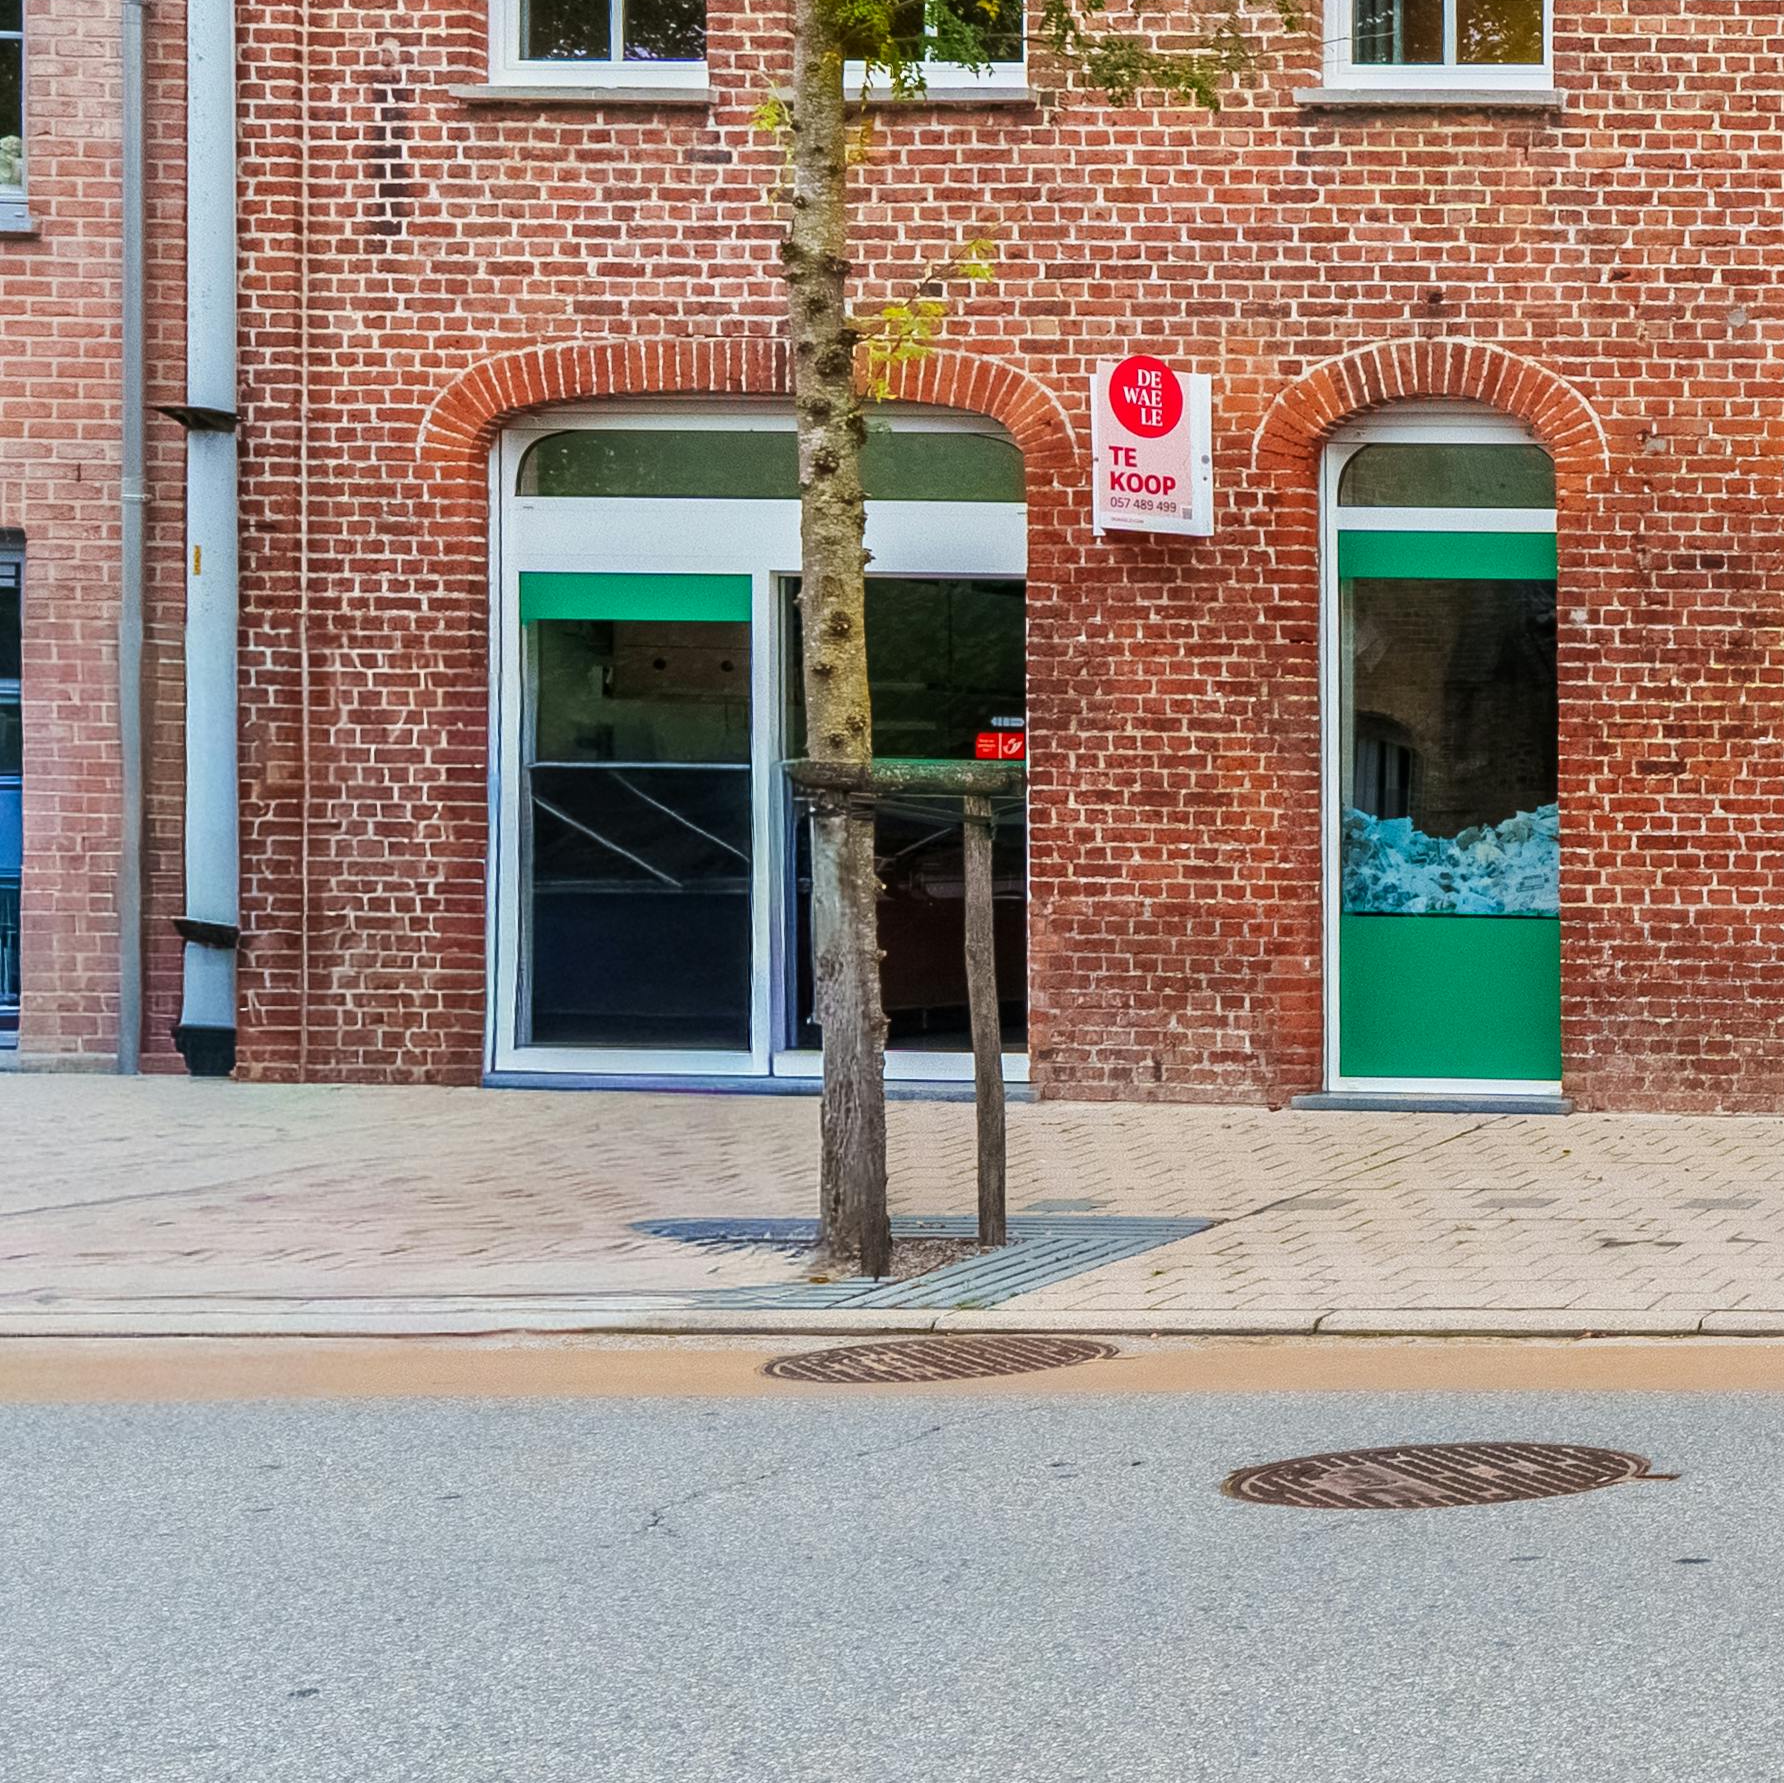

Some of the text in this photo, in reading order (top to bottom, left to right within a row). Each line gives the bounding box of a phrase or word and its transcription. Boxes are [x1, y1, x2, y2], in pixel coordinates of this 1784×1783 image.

[1137, 369, 1163, 389] DE
[1123, 386, 1163, 408] WAE
[1140, 407, 1164, 427] LE
[1109, 446, 1137, 468] TE
[1110, 471, 1176, 496] KOOP
[1110, 497, 1177, 513] 057 489 499
